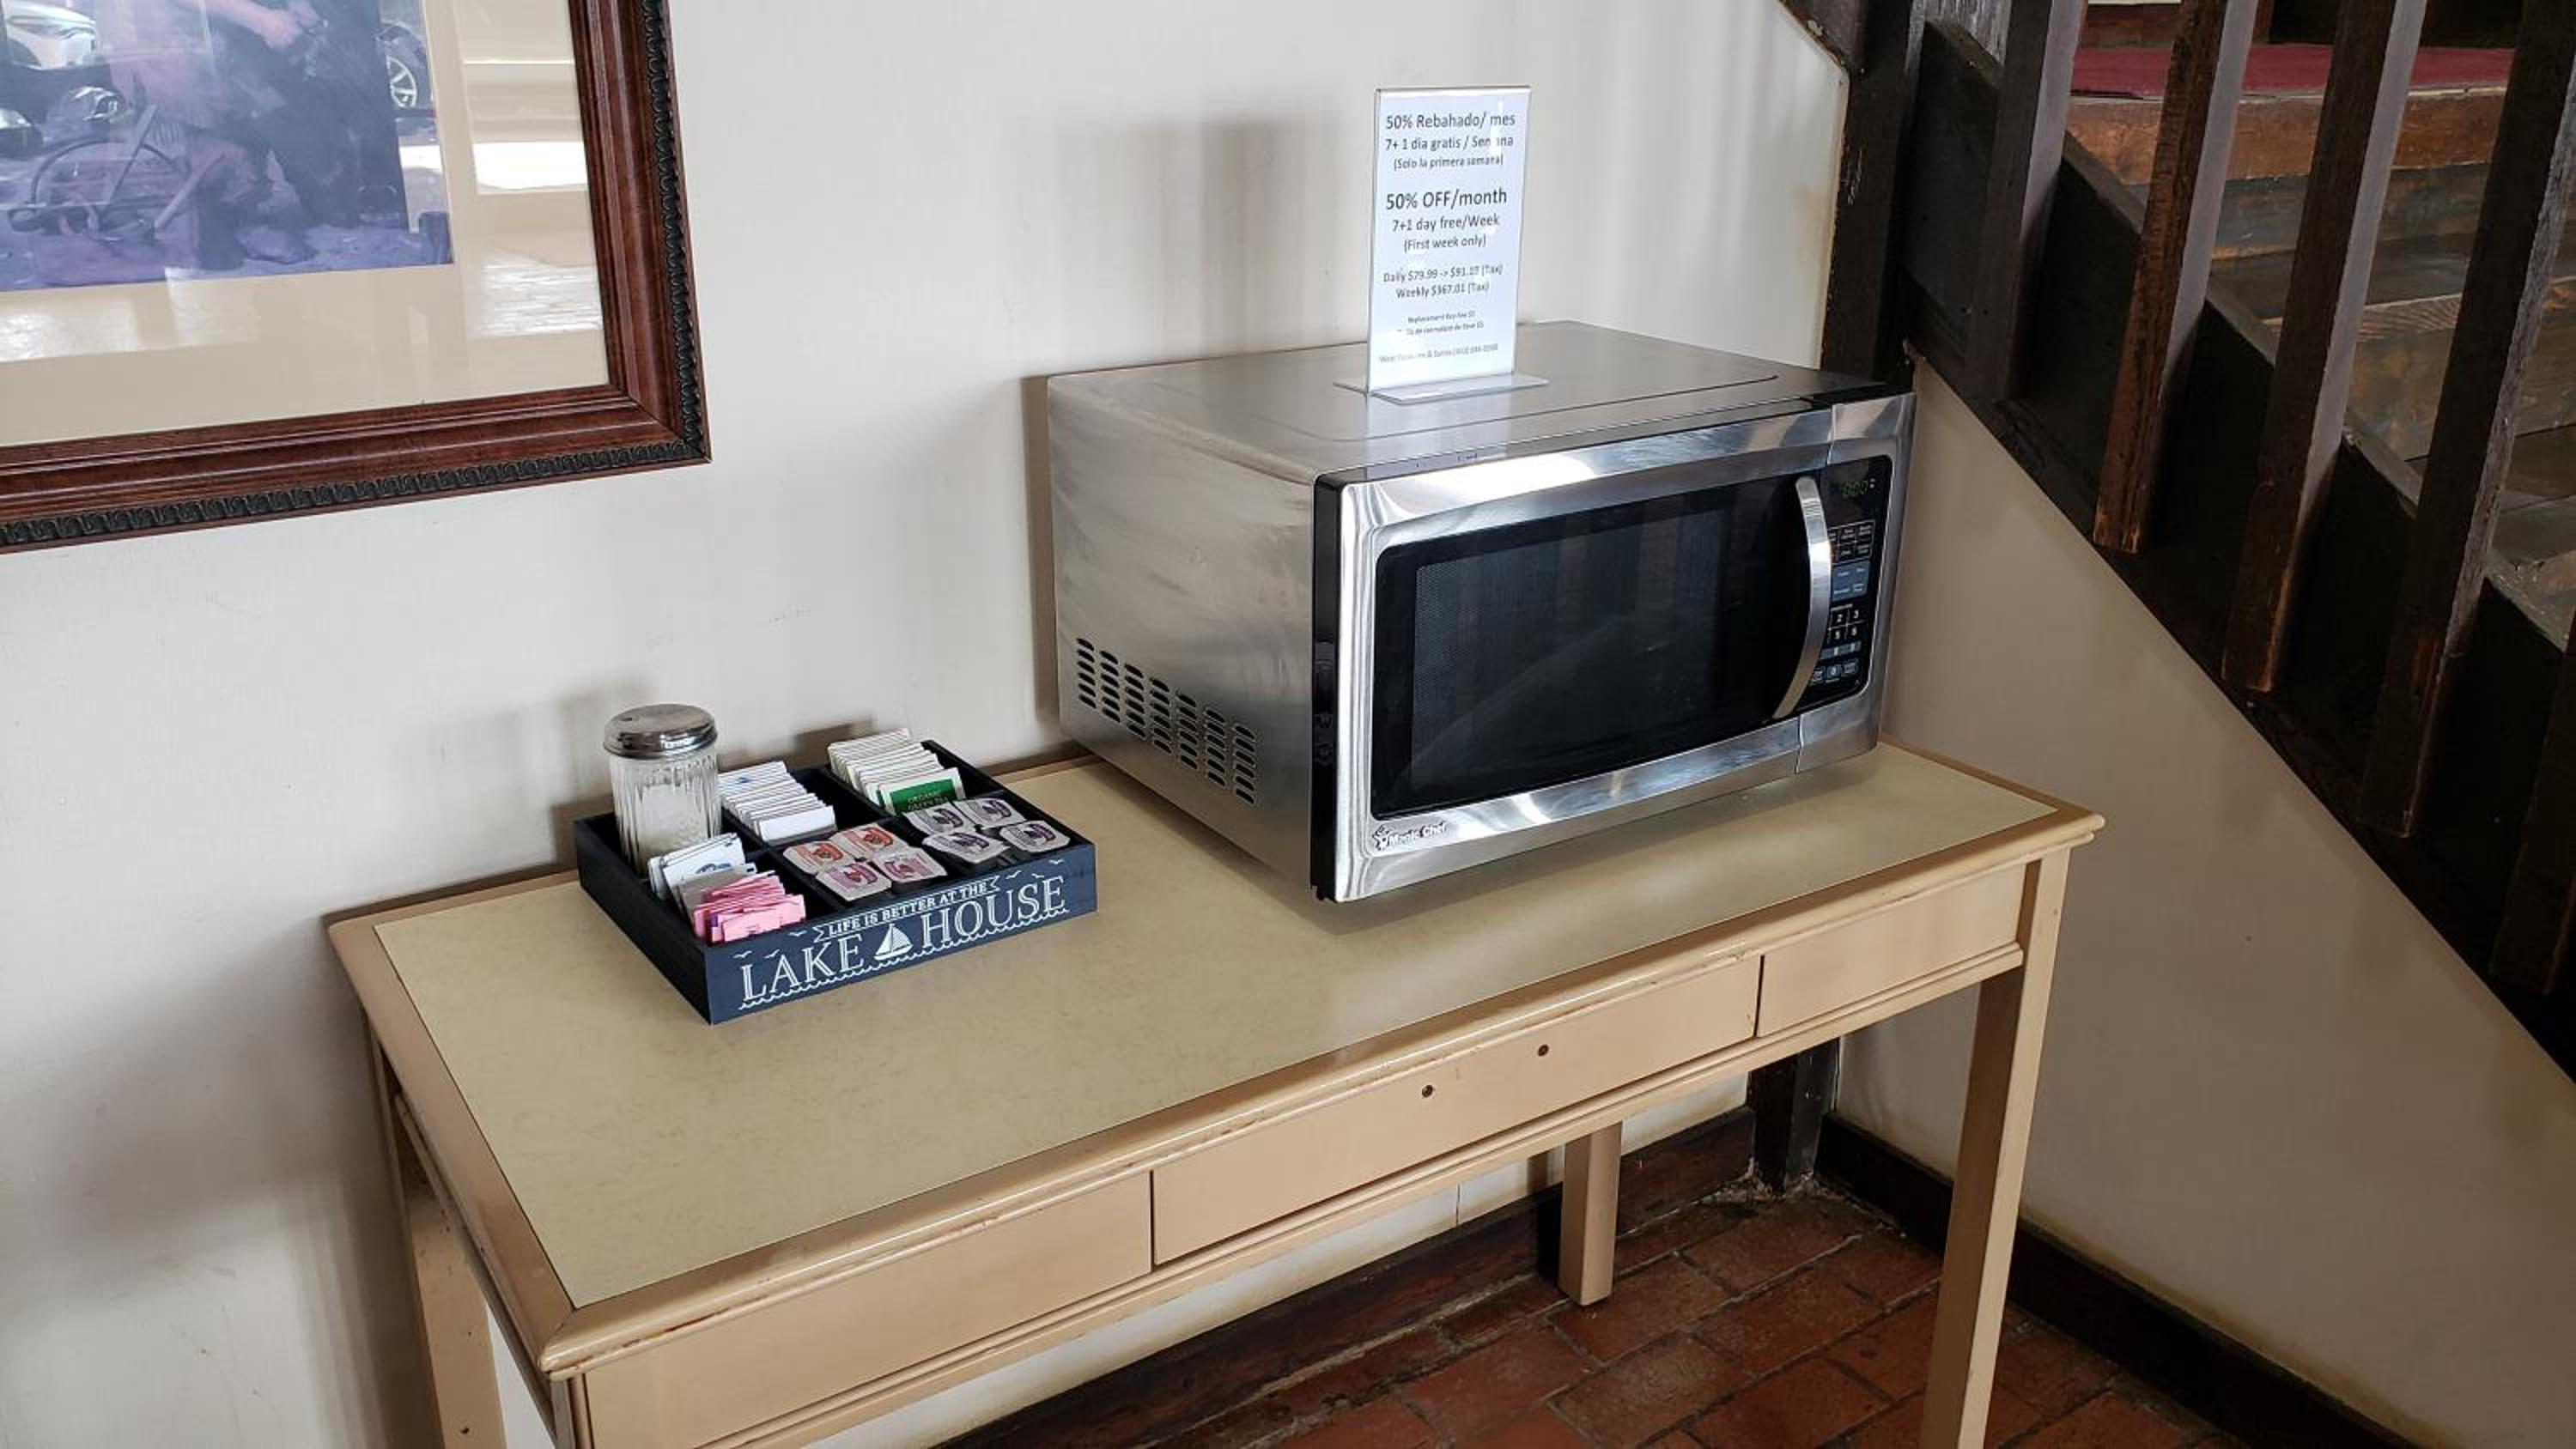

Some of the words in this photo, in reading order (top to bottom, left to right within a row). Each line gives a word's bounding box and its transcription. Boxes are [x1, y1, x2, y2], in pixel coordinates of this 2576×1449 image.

[1386, 114, 1413, 130] 50%
[1430, 136, 1461, 151] gratis
[1430, 156, 1465, 169] primera
[1386, 192, 1418, 209] 50%
[1423, 187, 1507, 209] OFF/month
[1392, 218, 1413, 232] 7+1
[1417, 217, 1437, 232] day
[1439, 212, 1500, 230] free/Week
[1404, 239, 1430, 253] (First
[1431, 236, 1459, 249] week
[1461, 234, 1486, 247] only)
[1383, 270, 1406, 283] Daily
[1395, 285, 1430, 299] Weekly
[829, 916, 860, 937] LIFE
[864, 912, 878, 926] IS
[882, 897, 936, 922] BETTER
[939, 890, 958, 908] AT
[961, 882, 990, 901] THE
[741, 932, 865, 1003] LAKE
[920, 875, 1066, 950] HOUSE
